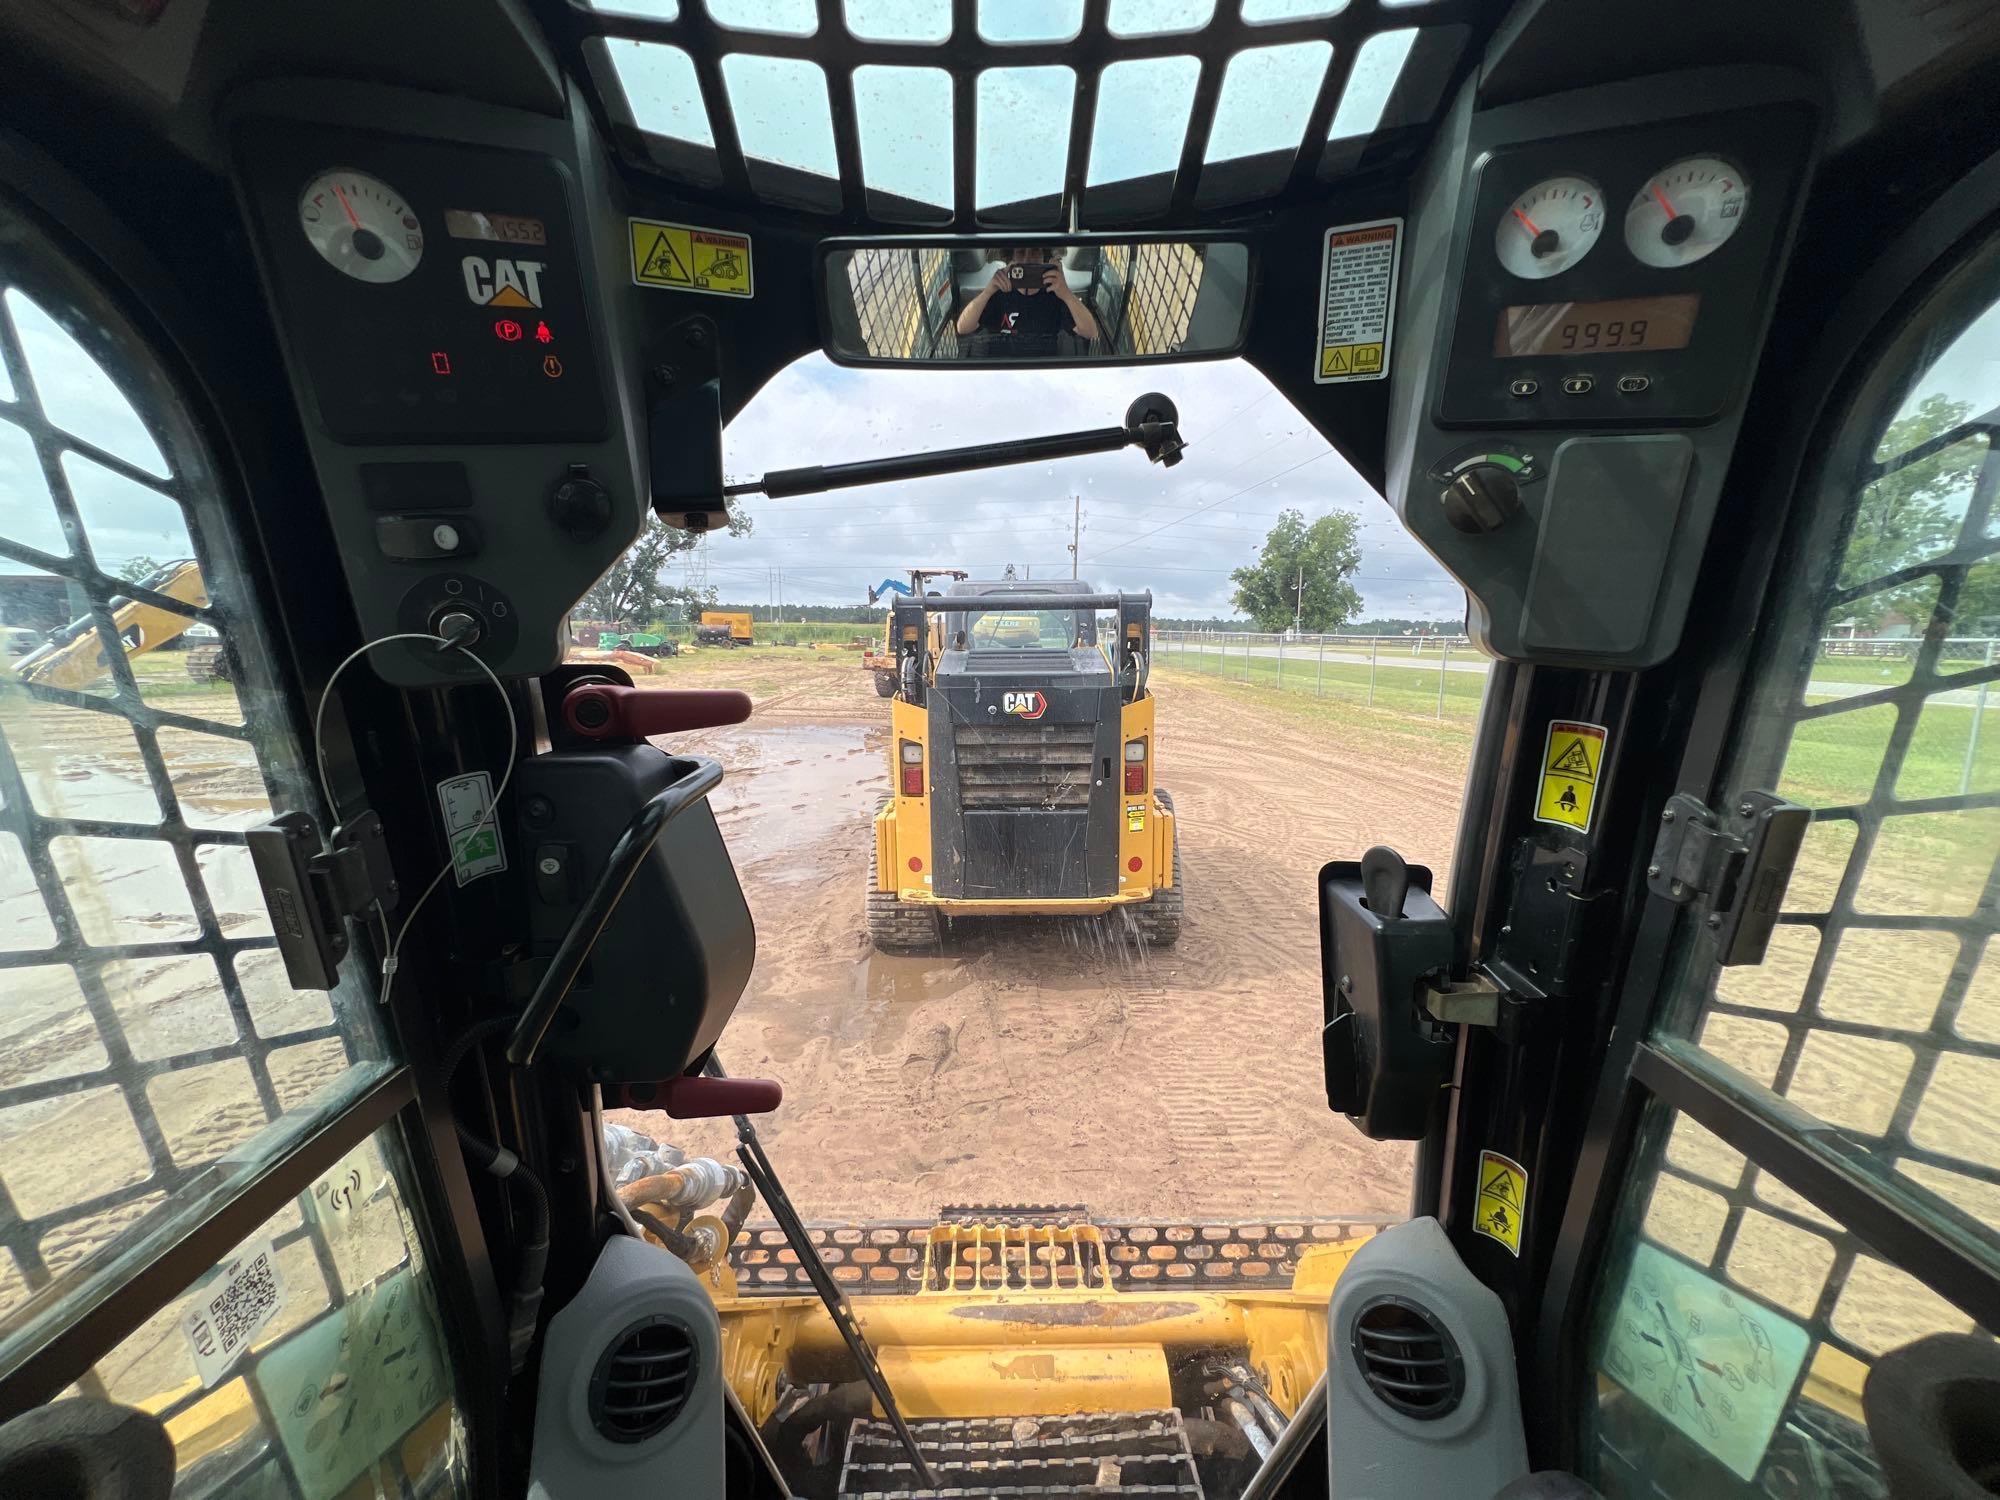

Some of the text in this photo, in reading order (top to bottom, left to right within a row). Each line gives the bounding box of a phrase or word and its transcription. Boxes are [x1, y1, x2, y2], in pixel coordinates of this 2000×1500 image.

[704, 236, 745, 248] WARNING
[1346, 230, 1392, 245] WARNING
[462, 256, 543, 308] CAT
[1003, 692, 1036, 713] CAT
